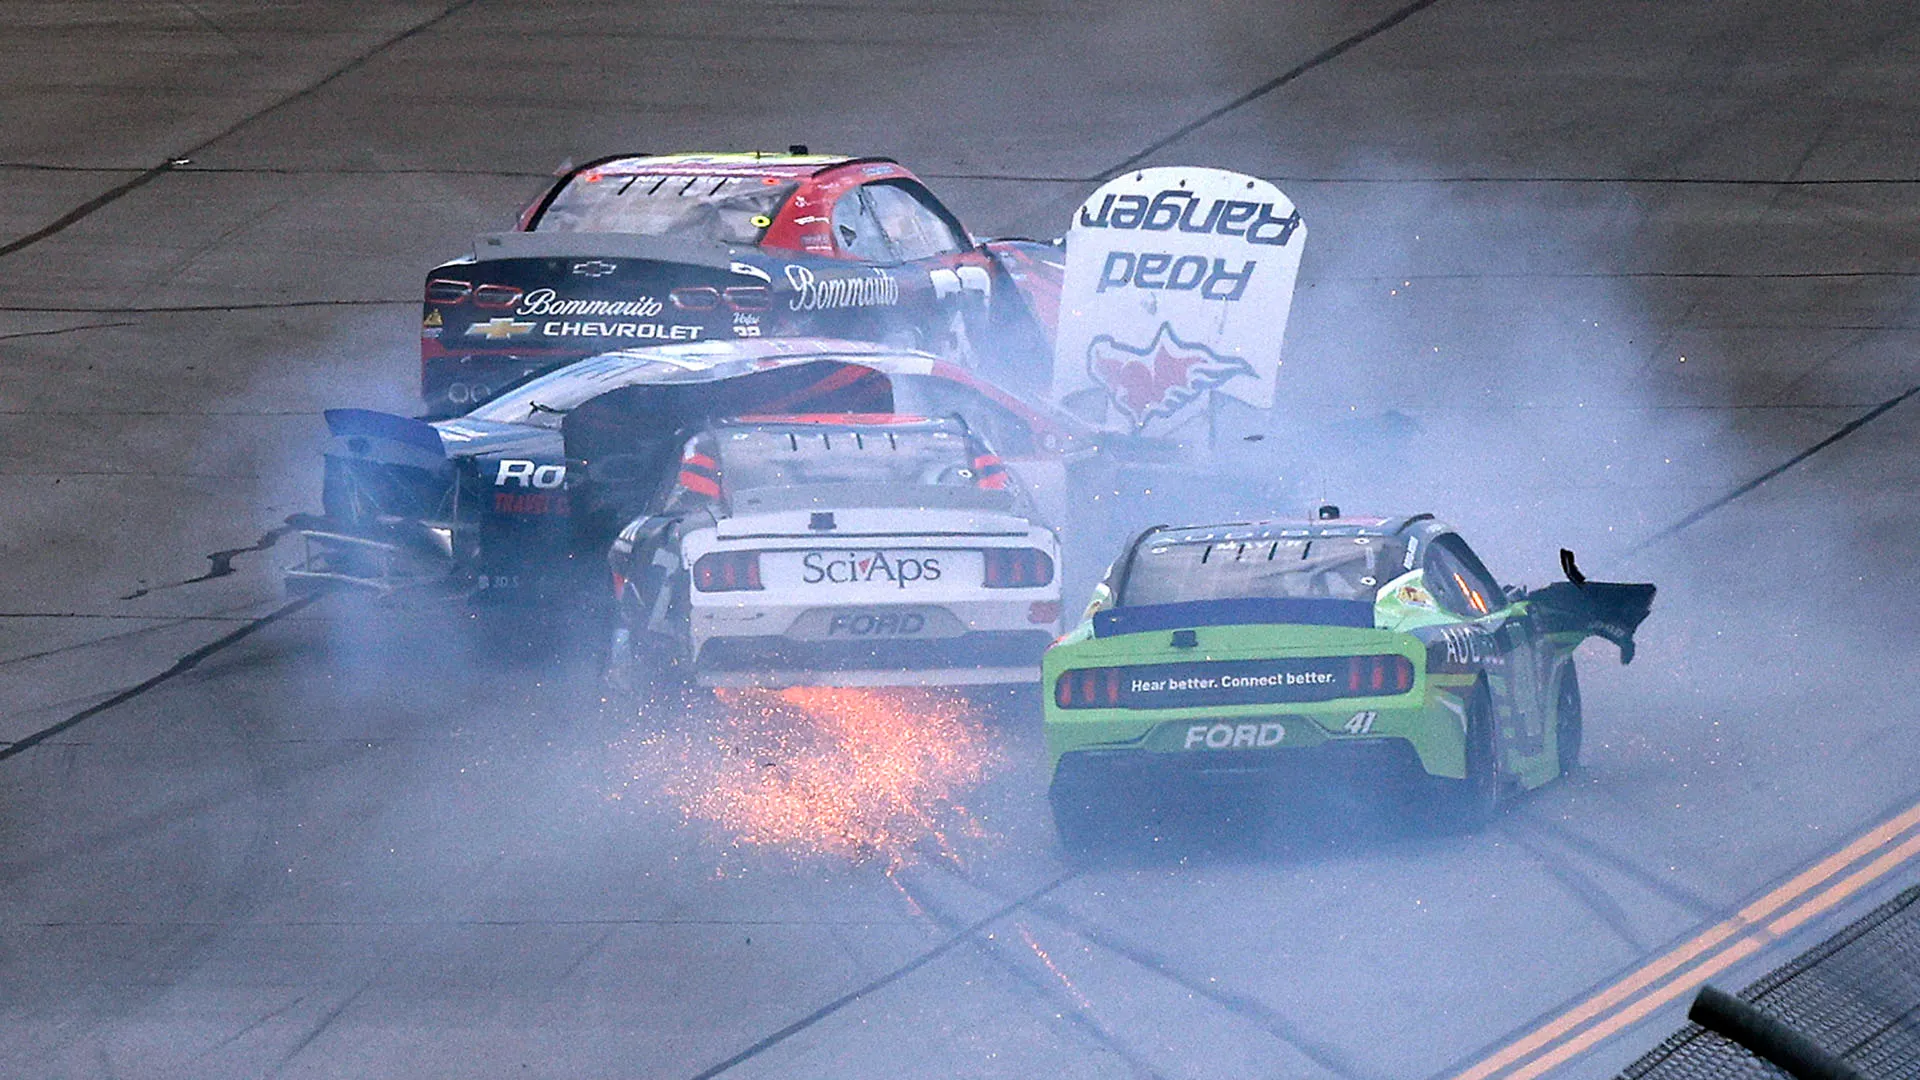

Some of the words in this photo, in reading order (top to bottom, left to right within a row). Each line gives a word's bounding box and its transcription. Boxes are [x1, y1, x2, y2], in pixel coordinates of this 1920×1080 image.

[1080, 190, 1300, 246] Ranger
[785, 265, 899, 311] Bommarito
[1096, 251, 1257, 301] Road
[517, 288, 663, 316] Bommarito
[543, 322, 704, 339] CHEVROLET
[495, 459, 568, 489] Ro
[803, 552, 941, 589] SciAps
[827, 613, 925, 635] FORD
[1131, 680, 1165, 692] Hear
[1169, 676, 1218, 690] better.
[1221, 674, 1283, 688] Connect
[1286, 671, 1336, 685] better.
[1184, 722, 1285, 749] FORD
[1343, 711, 1377, 734] 41
